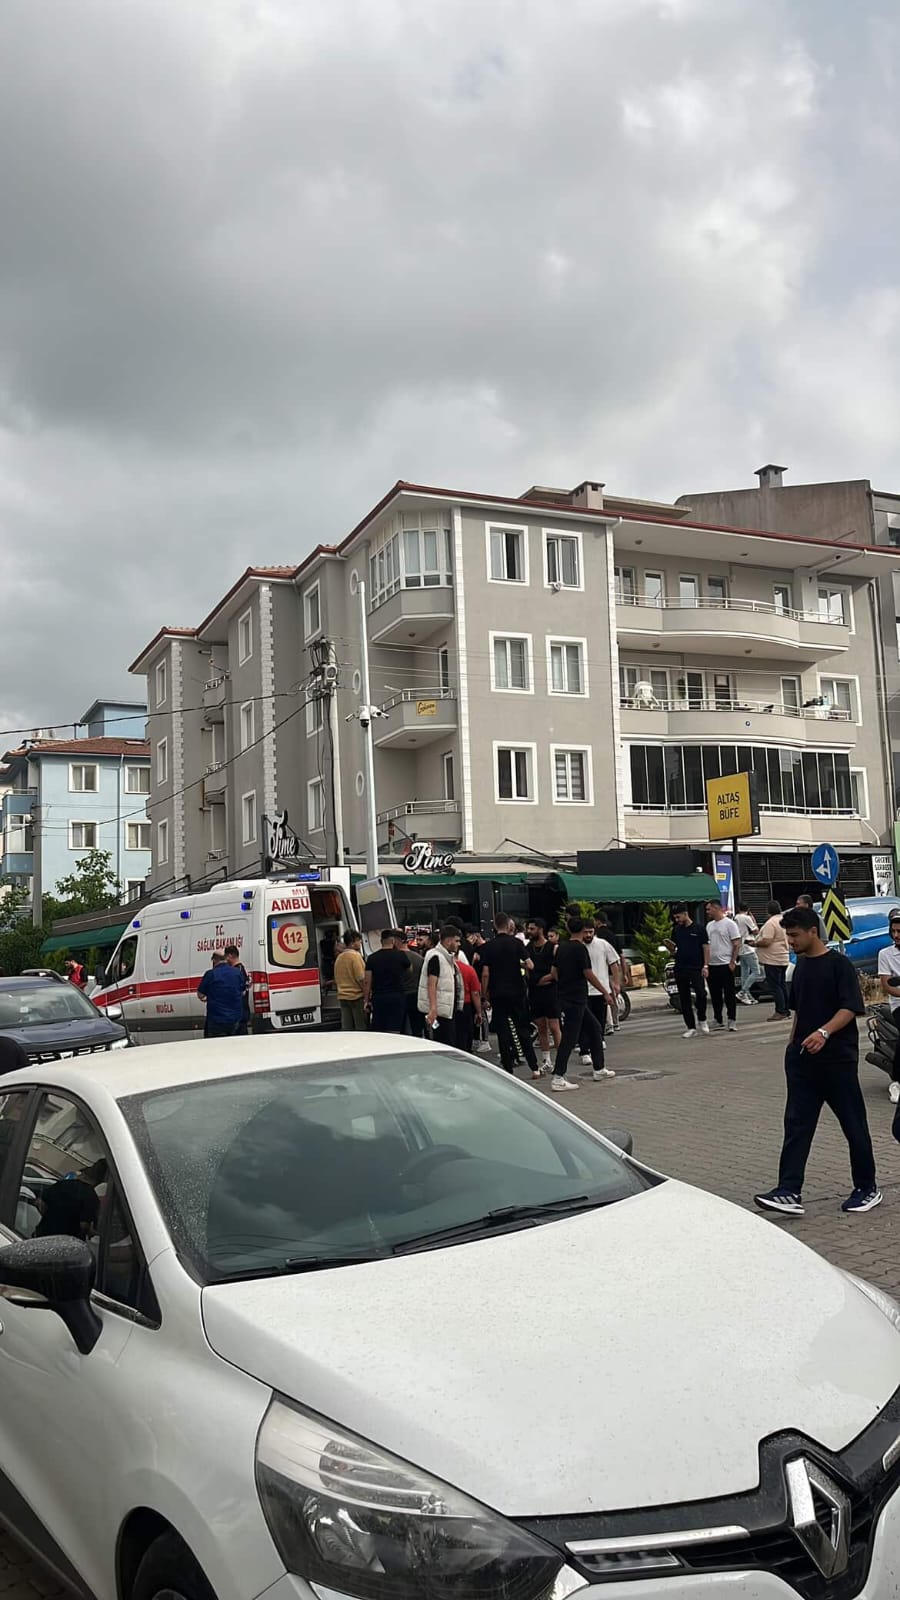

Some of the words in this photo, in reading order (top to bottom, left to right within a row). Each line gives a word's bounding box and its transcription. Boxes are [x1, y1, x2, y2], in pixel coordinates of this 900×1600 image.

[717, 791, 740, 806] ALTAŞ
[719, 806, 740, 820] BÜFE
[270, 810, 299, 859] Time
[404, 841, 455, 873] Time
[271, 898, 309, 911] AMBU
[284, 931, 303, 945] 112
